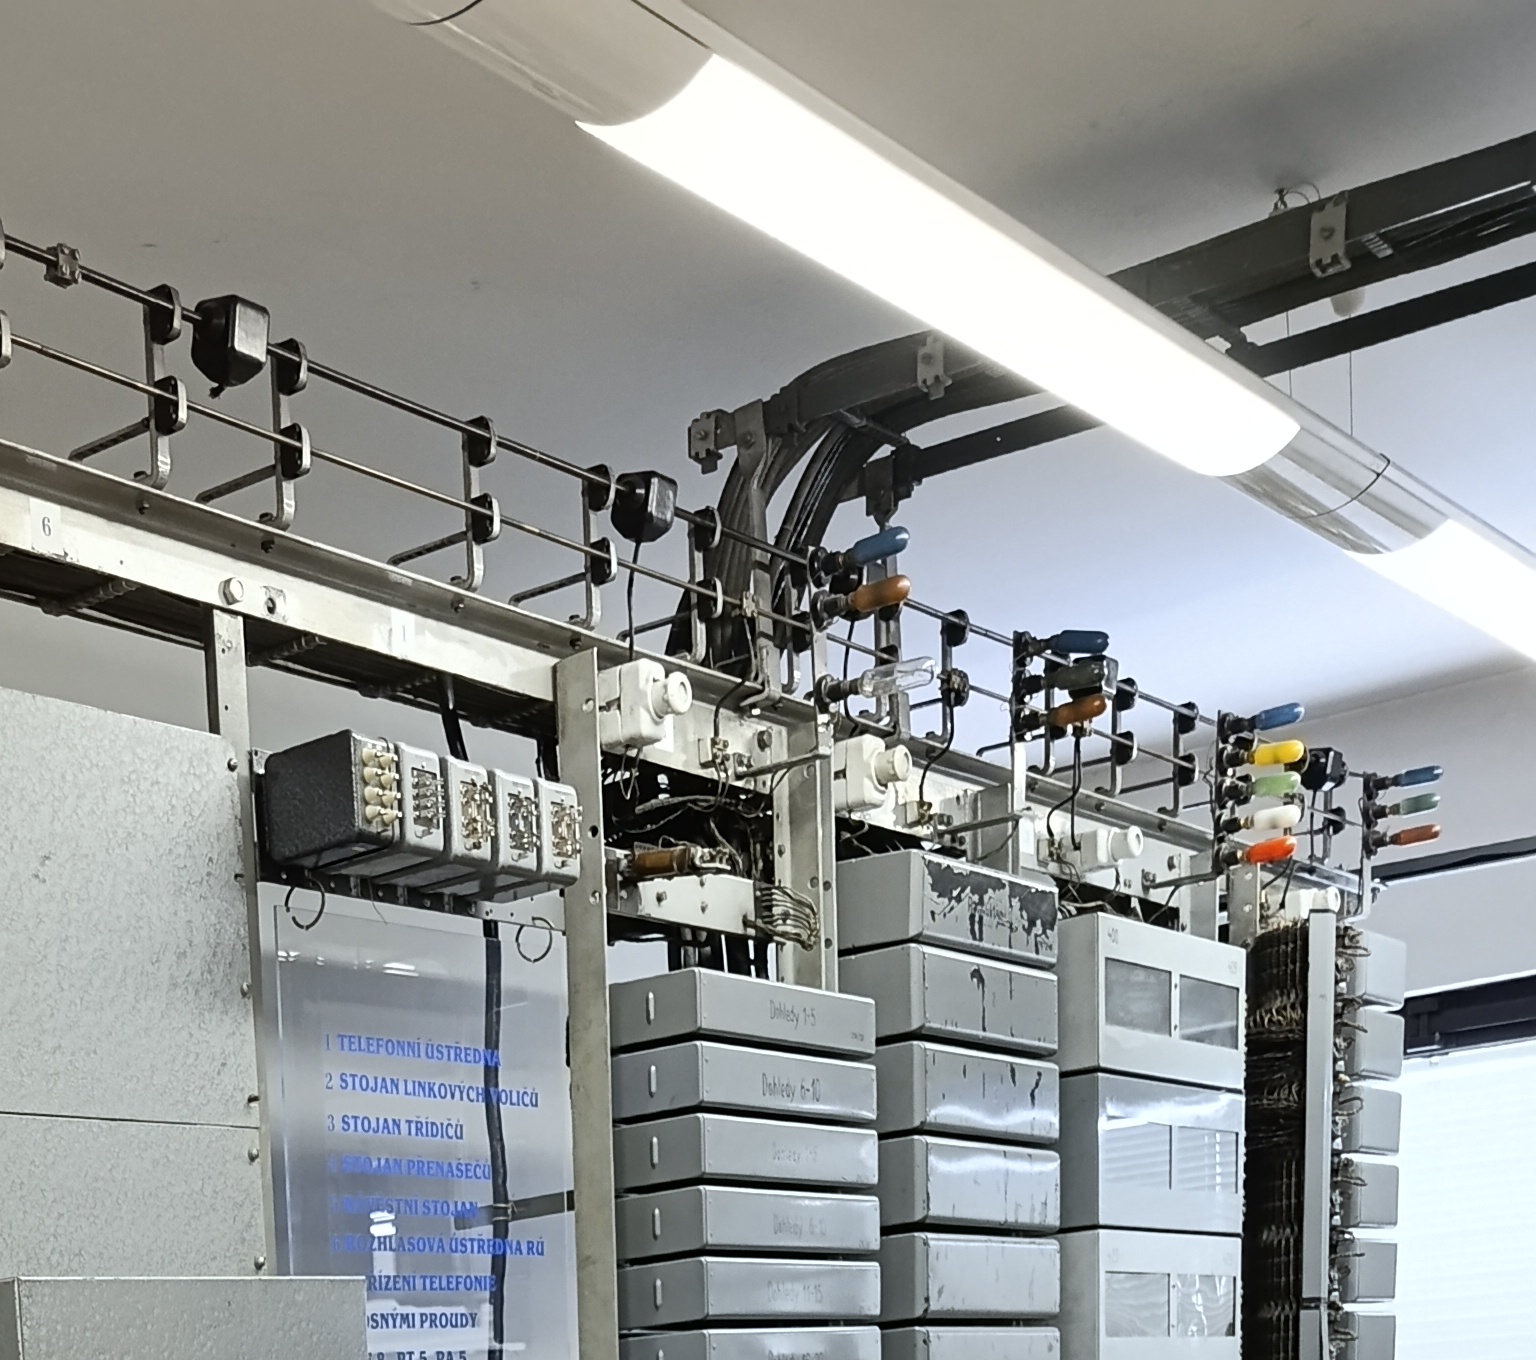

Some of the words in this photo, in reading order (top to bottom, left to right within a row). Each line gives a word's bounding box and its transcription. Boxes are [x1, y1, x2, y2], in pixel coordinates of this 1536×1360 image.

[41, 516, 52, 537] 6
[337, 1033, 422, 1059] TELEFONNÍ
[324, 1072, 334, 1090] 2
[339, 1072, 400, 1096] STOJAN
[403, 1080, 486, 1103] LINKOVÝCH
[327, 1114, 336, 1132] 3
[341, 1114, 402, 1136] STOJAN
[341, 1156, 403, 1175] STOJAN
[422, 1199, 479, 1218] STOJAN
[421, 1274, 497, 1292] TELEFONIE
[366, 1308, 416, 1329] SNÝMI
[419, 1311, 478, 1329] PROUDY
